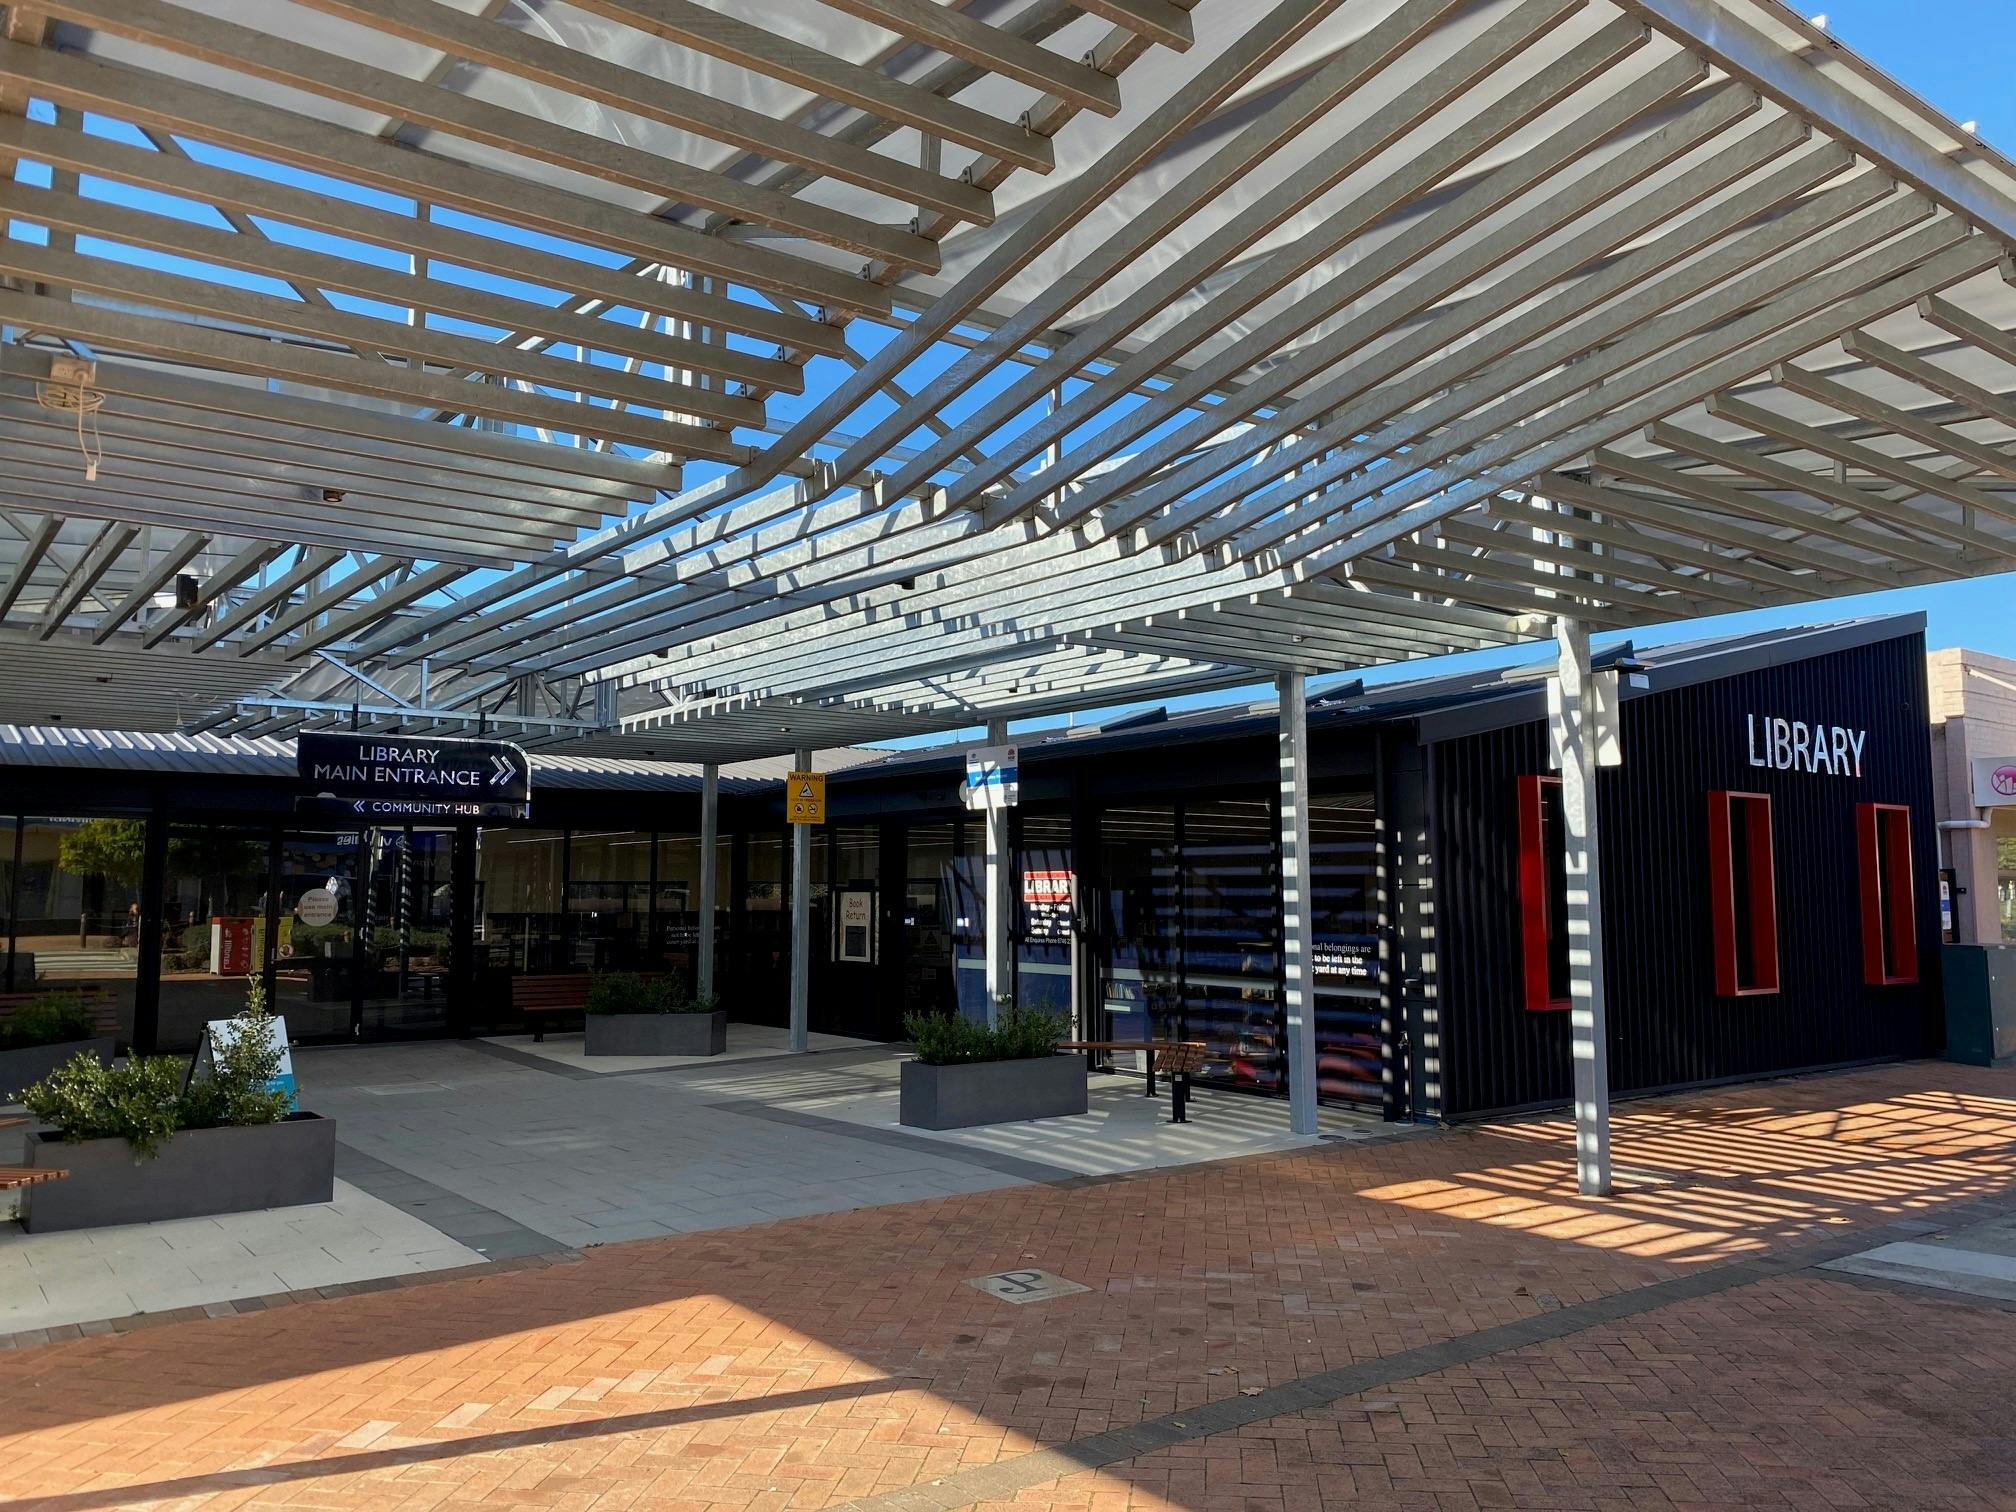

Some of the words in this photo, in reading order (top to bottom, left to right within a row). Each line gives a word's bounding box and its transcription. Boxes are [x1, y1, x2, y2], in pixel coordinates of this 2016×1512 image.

[1747, 713, 1866, 778] LIBRARY
[359, 745, 440, 764] LIBRARY
[314, 763, 367, 782] MAIN
[374, 766, 480, 786] ENTRANCE
[789, 773, 824, 783] WARNING
[372, 802, 451, 814] COMMUNITY
[454, 804, 480, 815] HUB
[848, 897, 864, 908] Book
[845, 909, 866, 920] Return
[1324, 942, 1359, 954] belongings
[1314, 954, 1321, 962] to
[1322, 954, 1331, 963] be
[1331, 954, 1343, 963] left
[1344, 954, 1351, 964] in
[1352, 955, 1363, 964] the
[1315, 965, 1329, 974] yard
[1330, 966, 1338, 974] at
[1338, 967, 1350, 976] any
[1351, 966, 1367, 976] time
